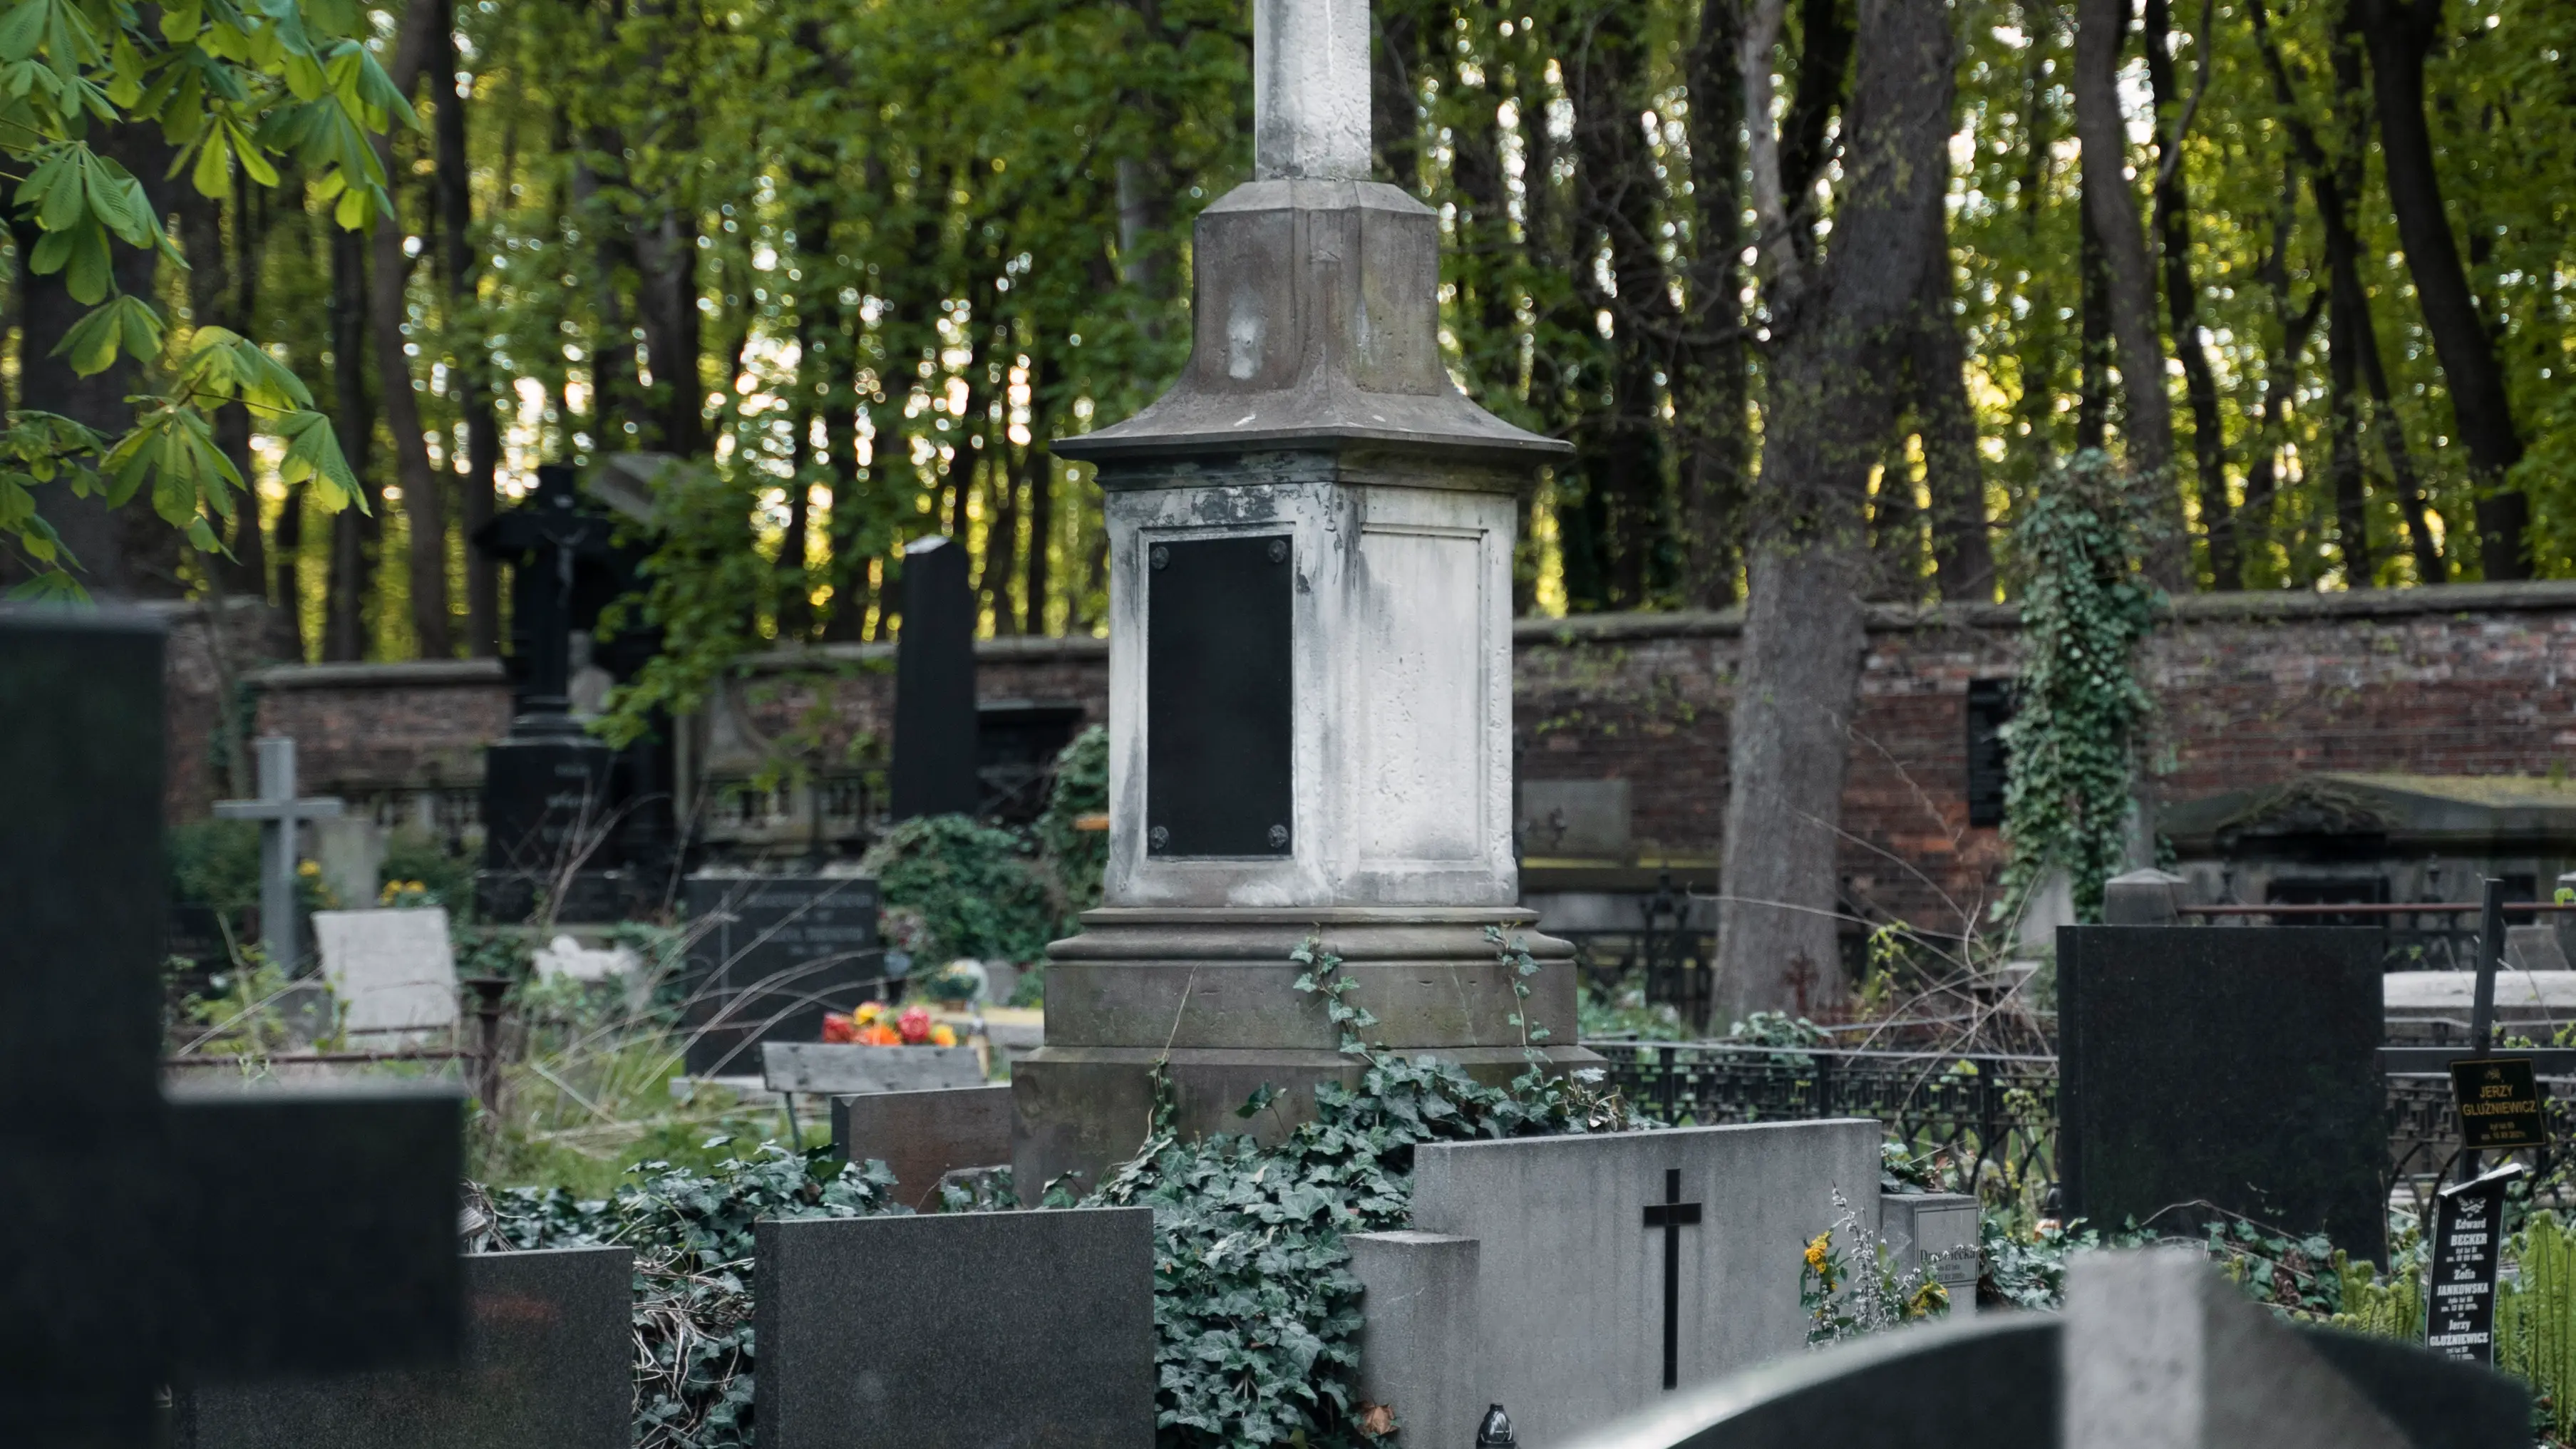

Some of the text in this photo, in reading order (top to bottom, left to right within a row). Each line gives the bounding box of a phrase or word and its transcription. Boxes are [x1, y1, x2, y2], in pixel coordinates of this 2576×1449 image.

[2480, 1085, 2513, 1098] JERZY
[2455, 1217, 2487, 1230] Edward
[2451, 1233, 2488, 1247] BECKER
[2453, 1269, 2475, 1280] Zofia
[2437, 1282, 2489, 1296] JANKOWSKA
[2448, 1319, 2471, 1331] Jerzy
